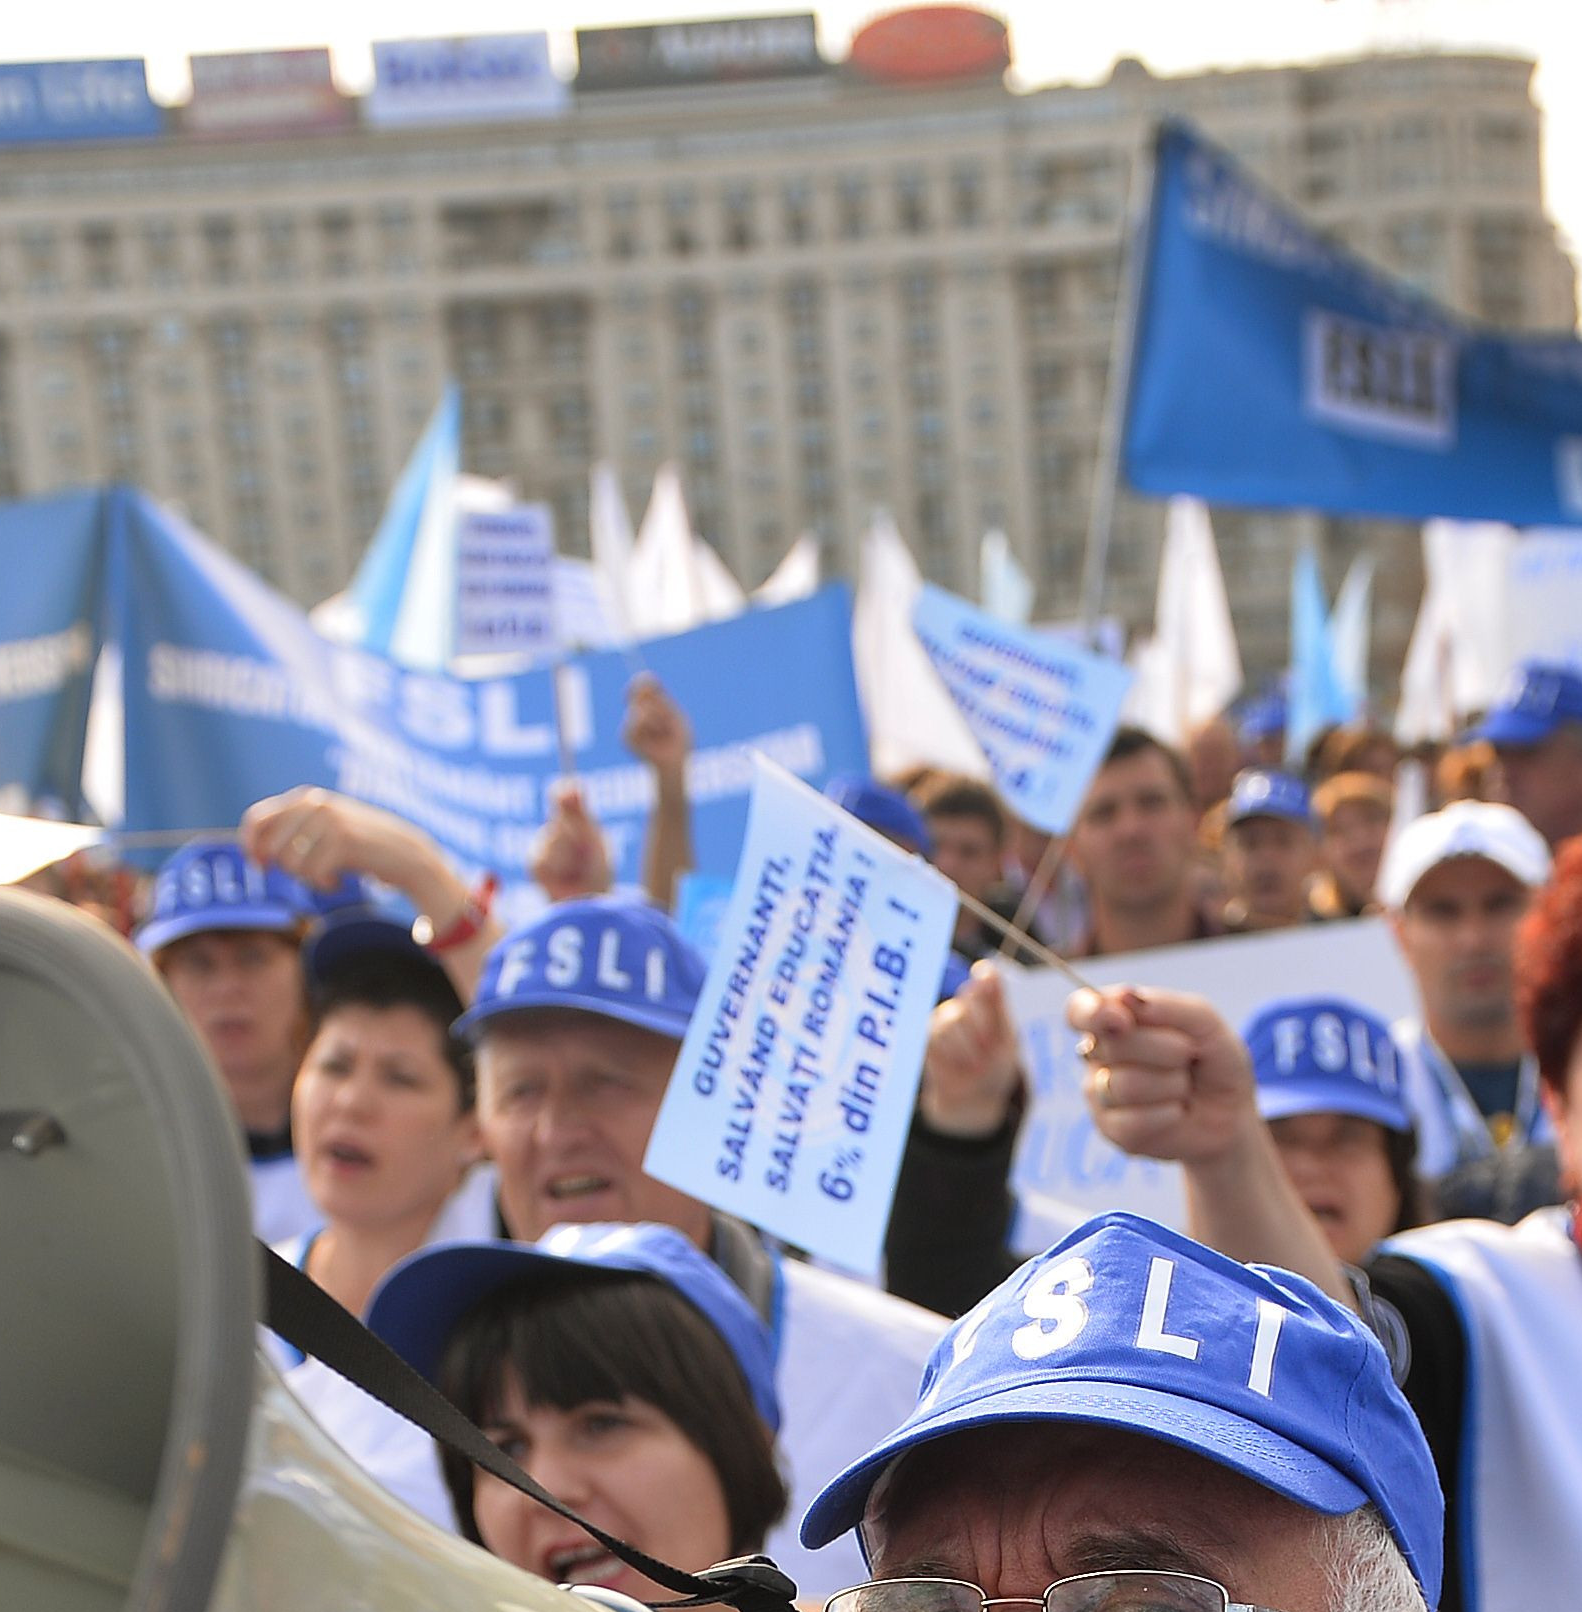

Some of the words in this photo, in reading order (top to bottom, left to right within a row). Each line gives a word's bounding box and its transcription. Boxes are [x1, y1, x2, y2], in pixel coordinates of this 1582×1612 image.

[495, 924, 668, 1001] FSLI
[855, 938, 915, 1051] P.I.B.
[717, 1008, 781, 1184] SALVÂND
[1273, 1010, 1400, 1096] FSLI
[764, 1040, 823, 1194] SALVAȚI
[837, 1058, 882, 1136] din
[820, 1144, 866, 1203] 6%
